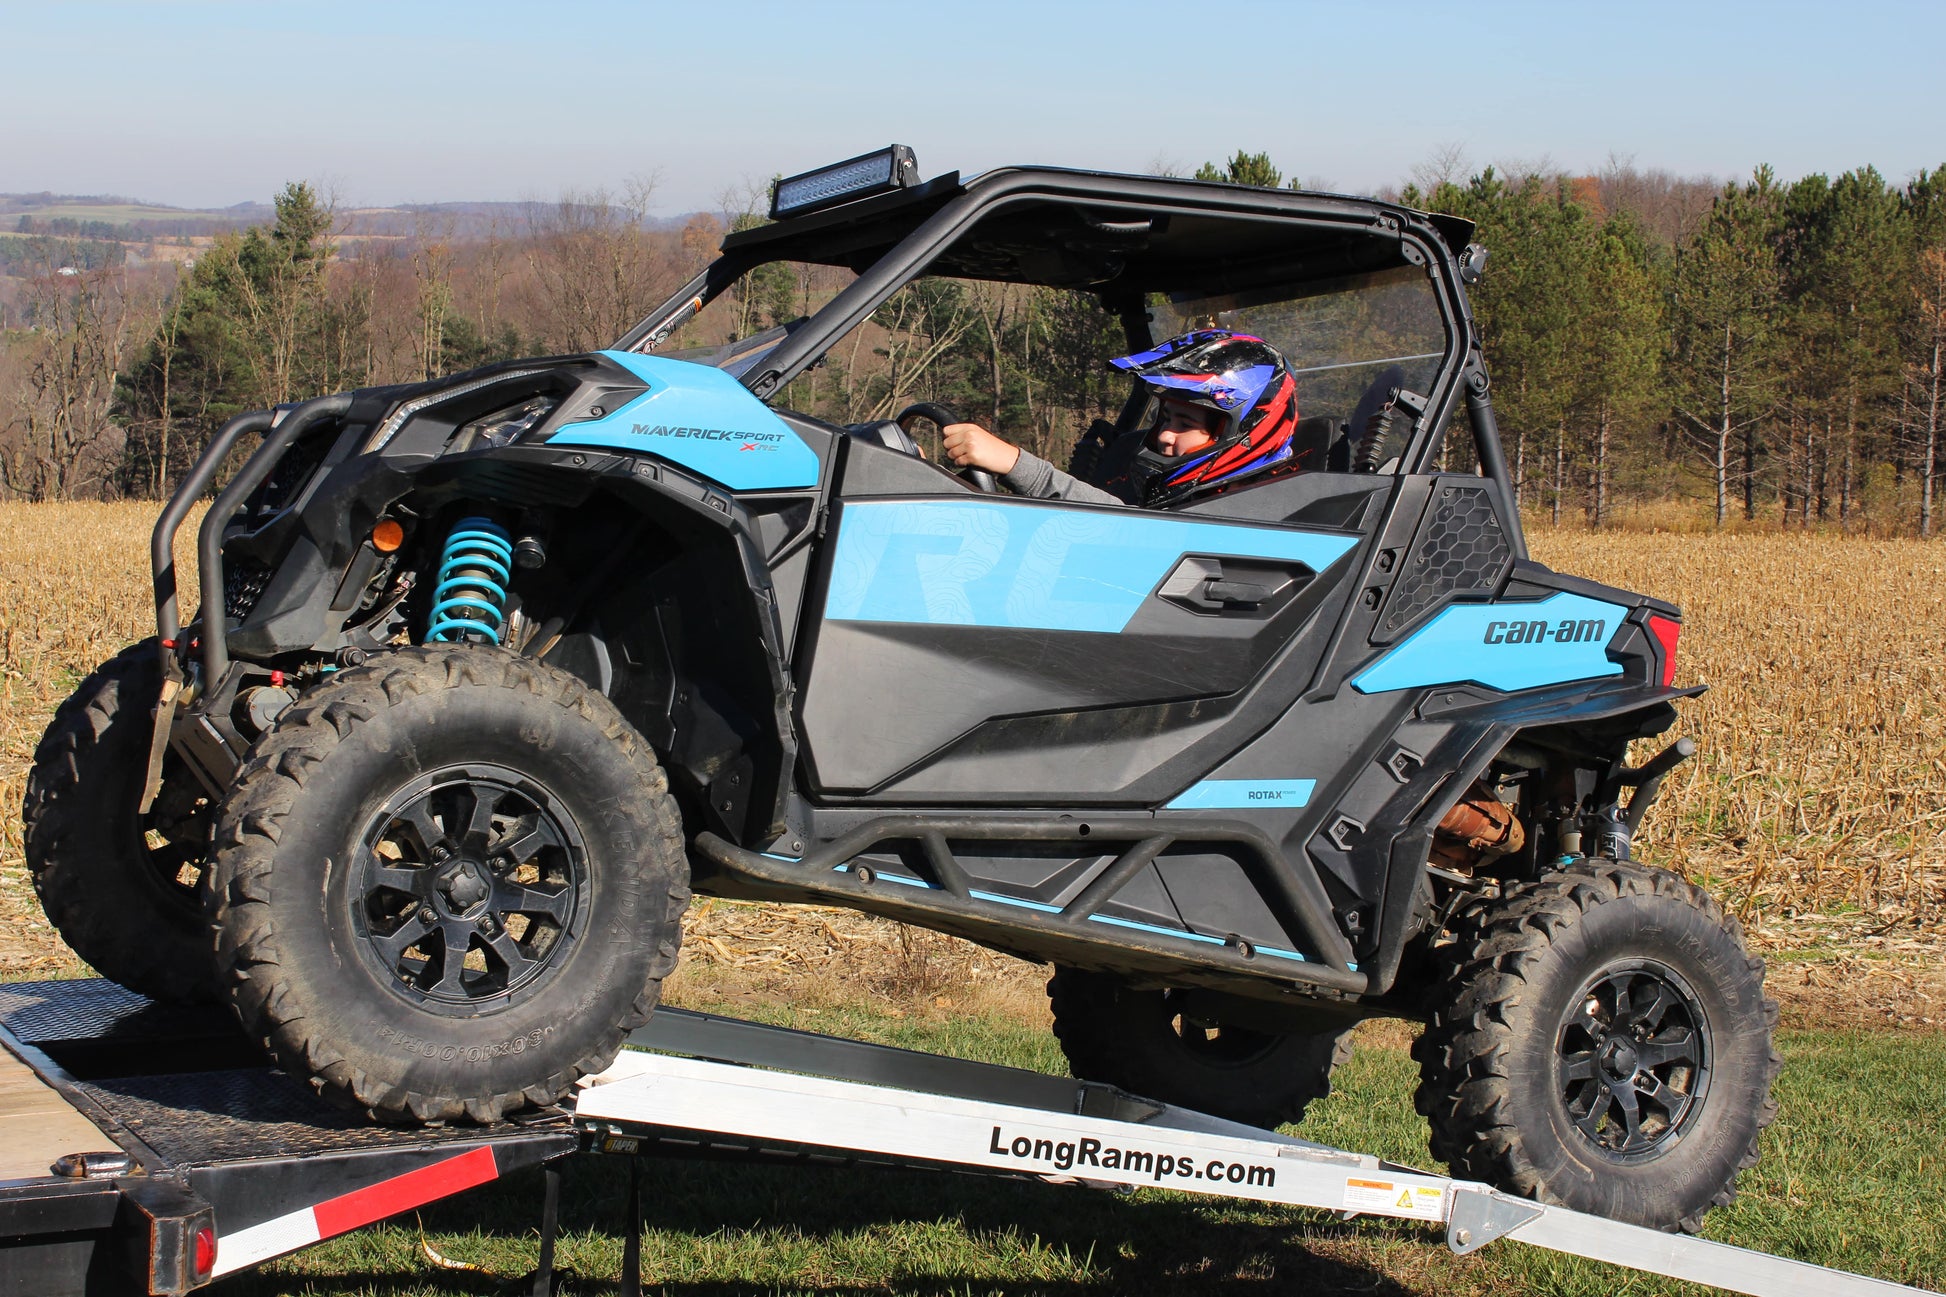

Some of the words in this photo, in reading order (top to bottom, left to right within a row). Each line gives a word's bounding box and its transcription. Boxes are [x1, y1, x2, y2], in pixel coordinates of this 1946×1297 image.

[631, 423, 732, 441] MAVERICK
[733, 431, 785, 442] SPORT
[826, 503, 1180, 632] RC
[1483, 619, 1606, 645] can-am
[1248, 791, 1282, 800] ROTAX
[599, 796, 641, 943] KENDA
[989, 1126, 1277, 1188] LongRamps.com
